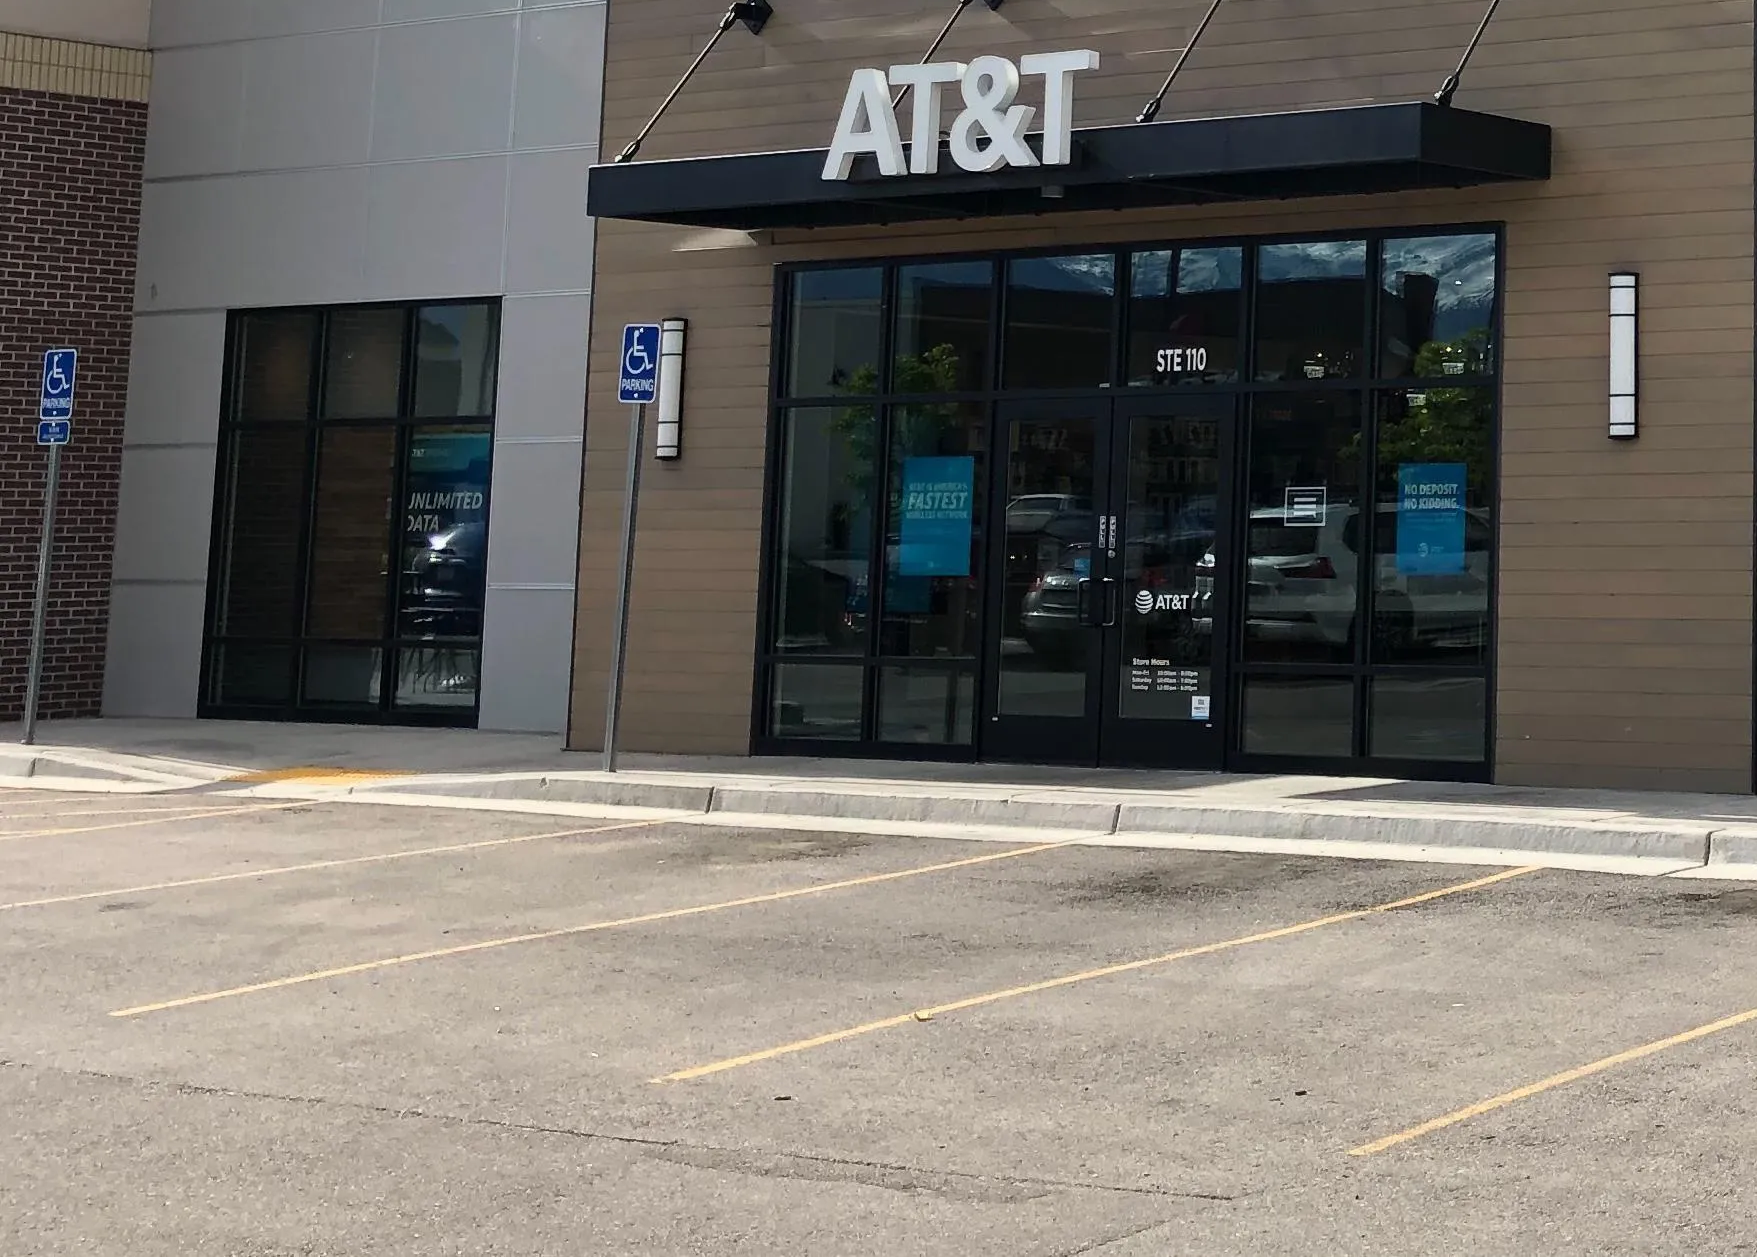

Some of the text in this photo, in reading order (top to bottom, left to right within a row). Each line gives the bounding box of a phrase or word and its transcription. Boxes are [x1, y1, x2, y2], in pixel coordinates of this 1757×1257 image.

[821, 49, 1100, 180] AT&T
[1156, 347, 1207, 372] STE 110
[621, 378, 654, 392] PARKING
[1405, 484, 1418, 495] NO
[907, 491, 968, 510] FASTEST
[1404, 498, 1417, 510] NO
[1155, 594, 1190, 610] AT&T
